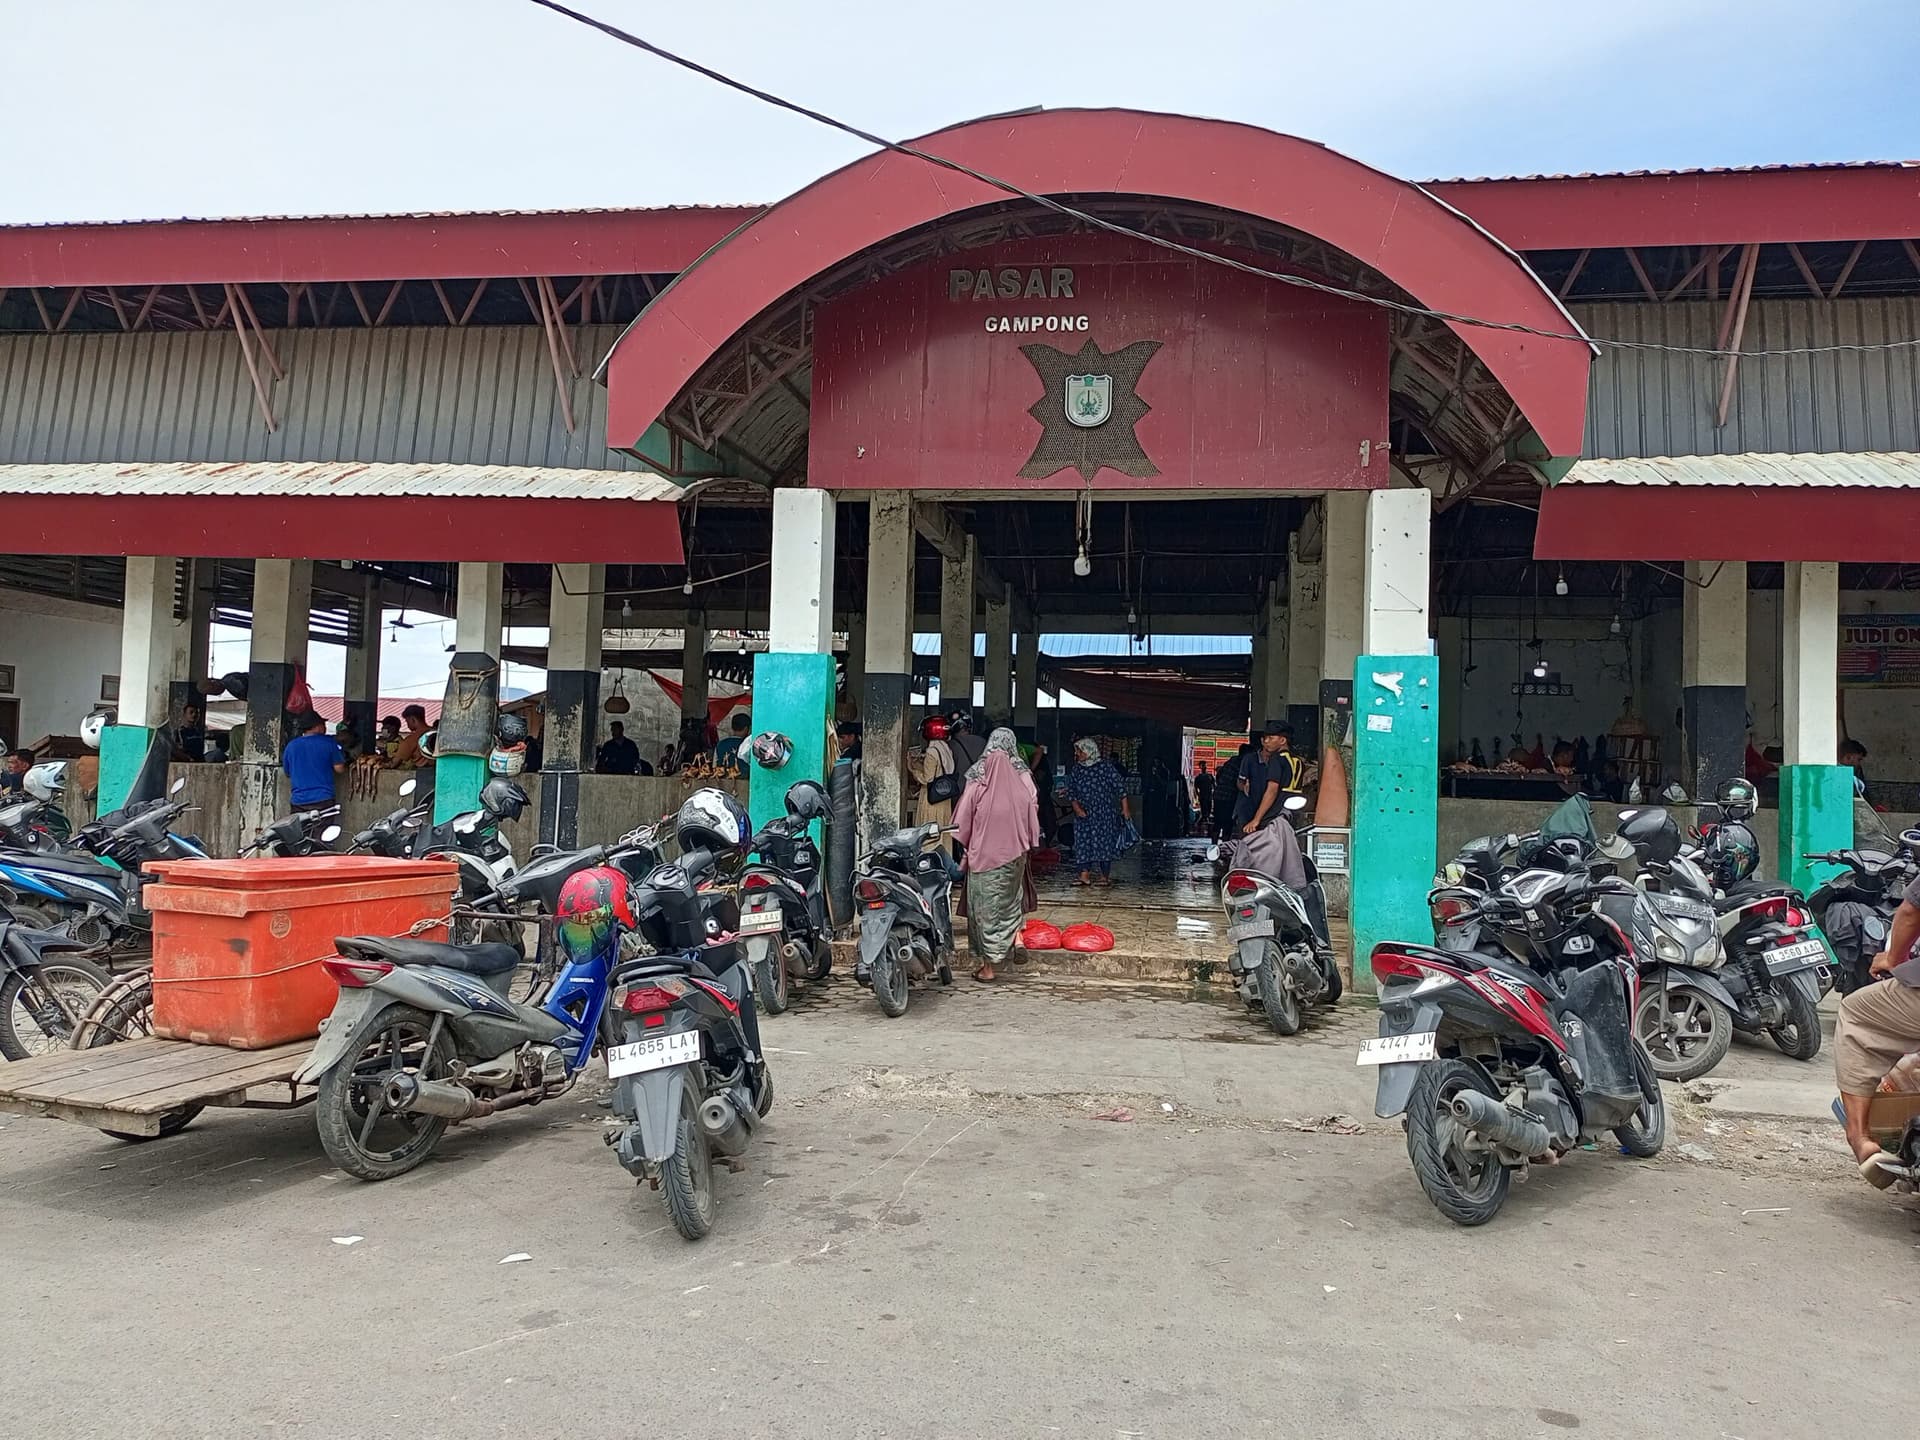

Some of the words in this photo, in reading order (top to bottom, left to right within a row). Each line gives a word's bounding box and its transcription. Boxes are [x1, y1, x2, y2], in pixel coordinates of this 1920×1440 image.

[950, 268, 1074, 300] PASAR
[985, 315, 1089, 332] GAMPONG
[1845, 627, 1890, 643] JUDI
[1766, 952, 1779, 964] BL
[609, 1047, 625, 1062] BL
[630, 1039, 664, 1058] 4655
[669, 1032, 697, 1050] LAY
[1360, 1040, 1372, 1052] BL
[1380, 1035, 1409, 1049] 4747
[1418, 1033, 1434, 1046] JV
[684, 1050, 697, 1060] 27
